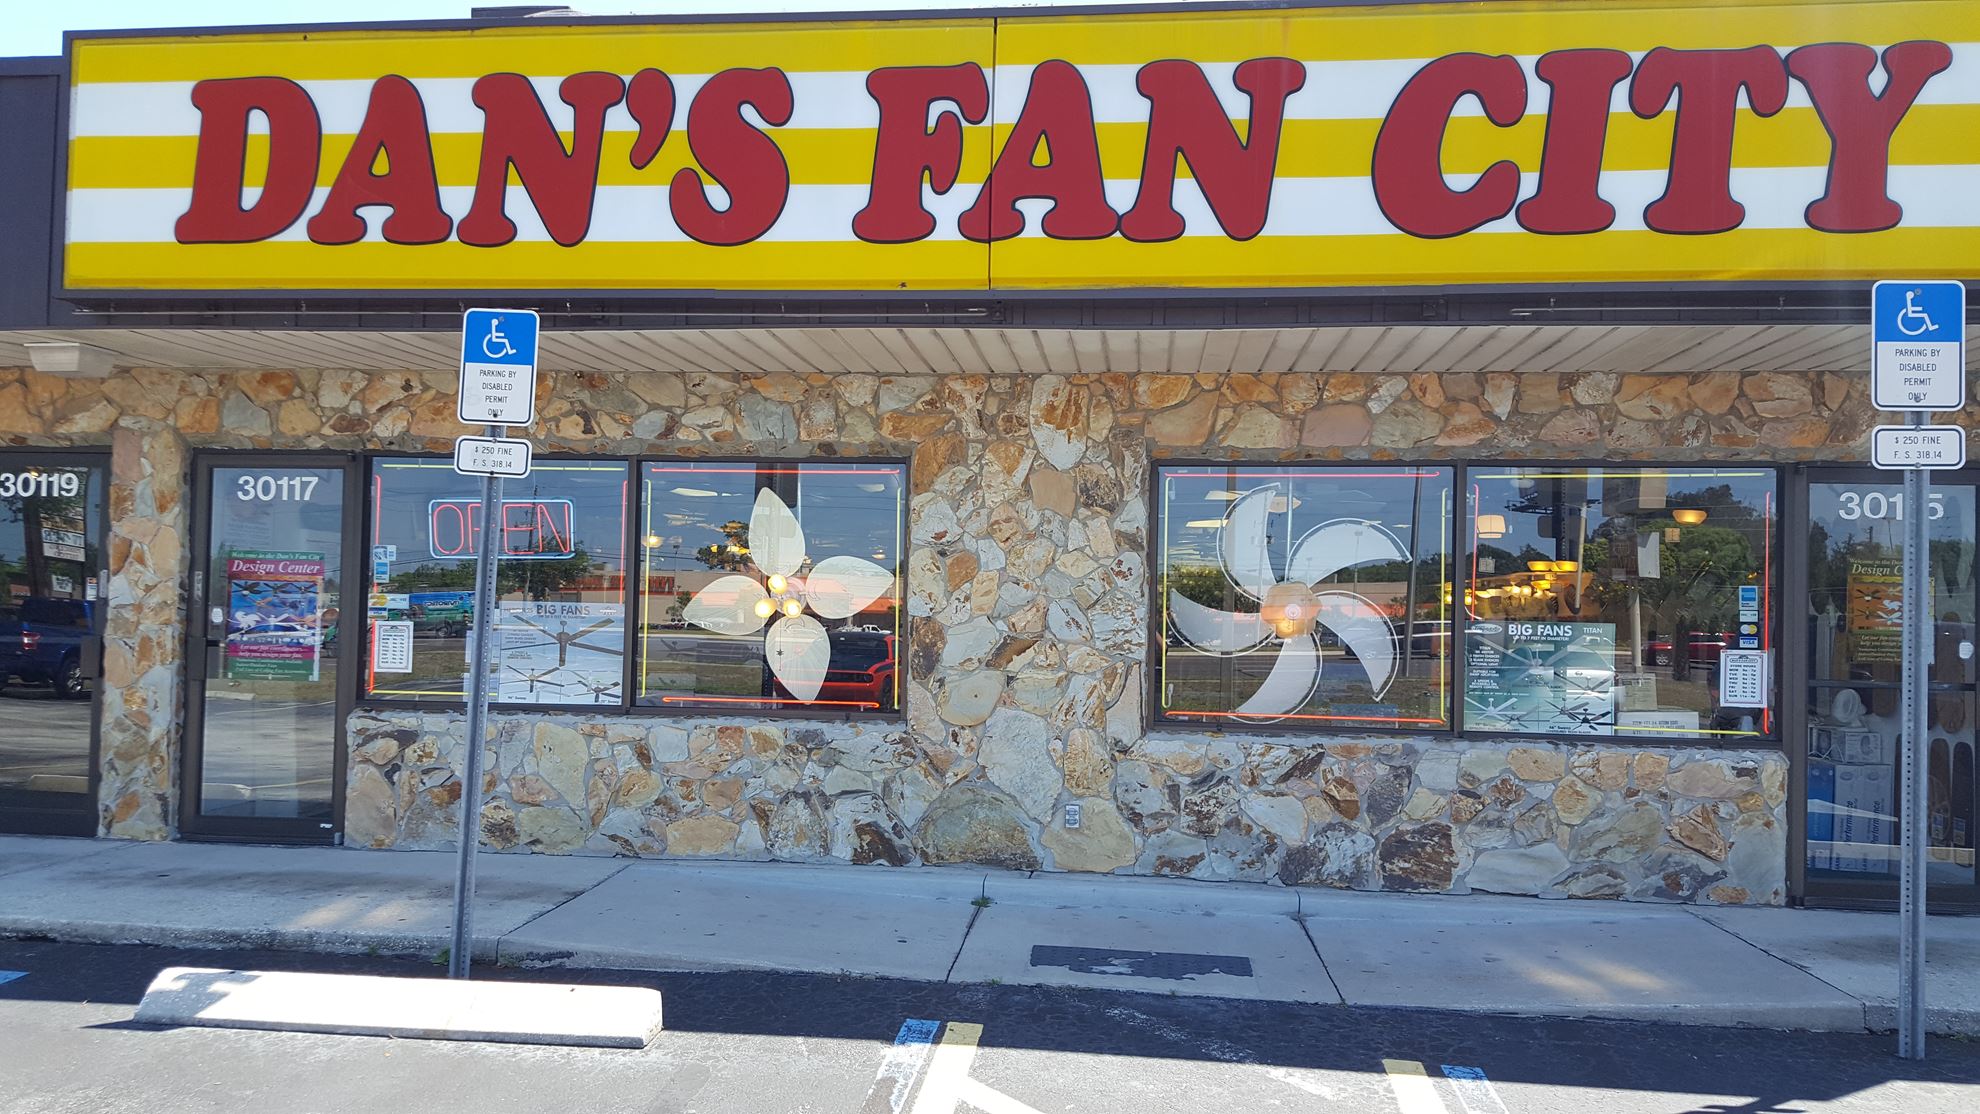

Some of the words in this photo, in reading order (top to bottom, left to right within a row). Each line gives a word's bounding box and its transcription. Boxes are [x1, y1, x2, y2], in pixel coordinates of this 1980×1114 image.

[173, 66, 795, 247] DAN'S
[851, 57, 1306, 243] FAN
[1372, 40, 1954, 239] CITY
[1895, 349, 1928, 357] PARKING
[1930, 349, 1941, 357] BY
[1899, 363, 1937, 371] DISABLED
[479, 369, 506, 378] PARKING
[508, 370, 517, 378] BY
[1904, 377, 1932, 386] PERMIT
[482, 382, 513, 391] DISABLED
[485, 395, 508, 404] PERMIT
[1908, 392, 1928, 401] ONLY
[487, 408, 504, 417] ONLY
[1903, 436, 1919, 445] 250
[1922, 436, 1941, 445] FINE
[481, 446, 495, 455] 250
[497, 447, 513, 456] FINE
[1916, 451, 1942, 459] 318.14
[491, 459, 512, 469] 318.14
[0, 472, 79, 497] 30119
[237, 475, 319, 501] 30117
[1838, 492, 1944, 520] 3015
[232, 560, 275, 575] Design
[278, 561, 321, 574] Center
[1852, 564, 1890, 576] Design
[536, 604, 557, 614] BIG
[561, 605, 591, 616] FANS
[1508, 624, 1533, 635] BIG
[1537, 625, 1573, 636] FANS
